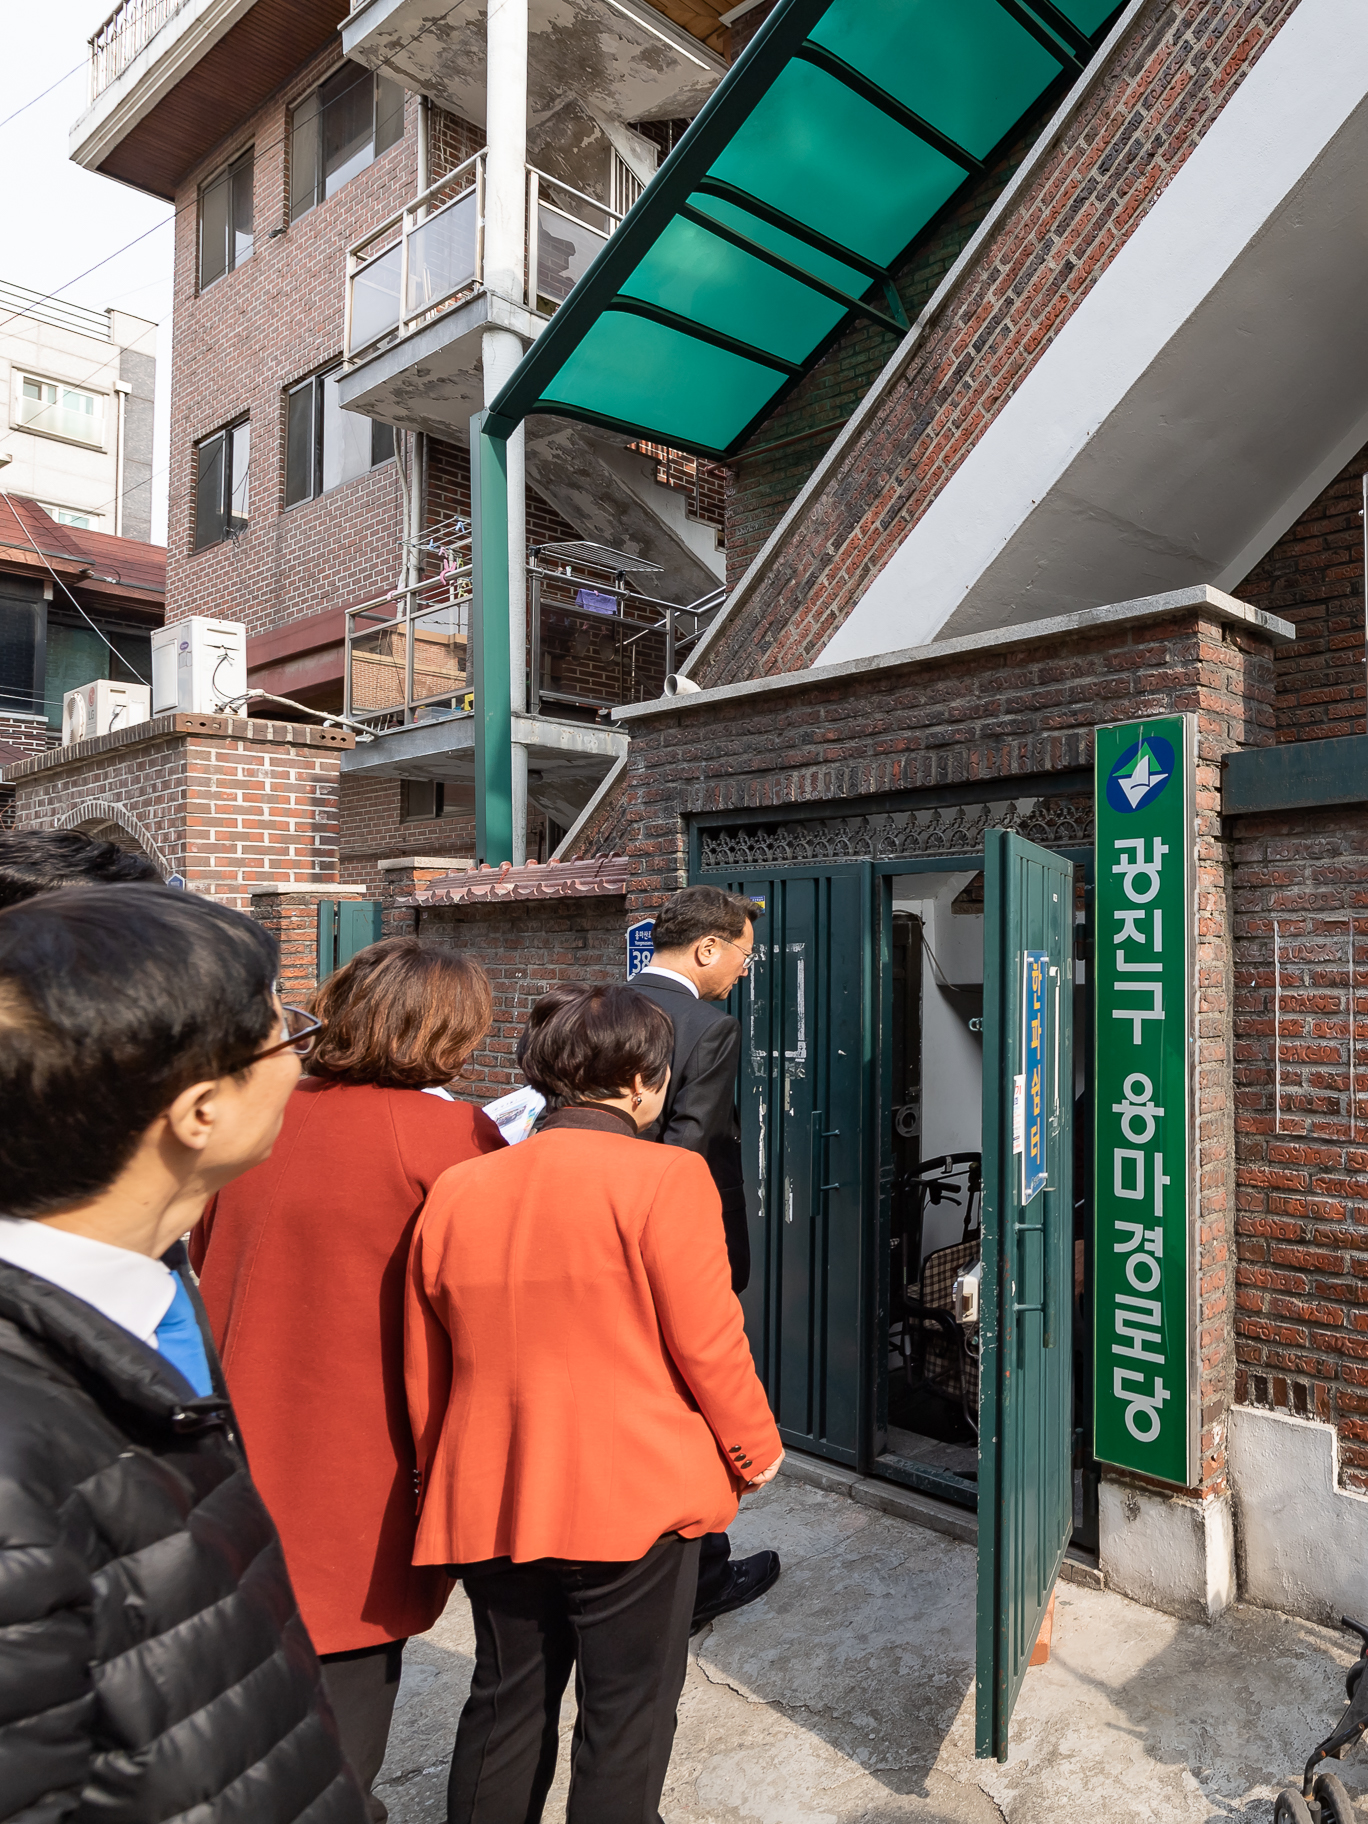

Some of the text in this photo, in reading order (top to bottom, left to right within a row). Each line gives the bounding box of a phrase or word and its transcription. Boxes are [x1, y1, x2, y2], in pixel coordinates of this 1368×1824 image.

[88, 709, 95, 721] LG
[632, 950, 651, 973] 38
[1030, 961, 1042, 1165] 한파쉼터
[1112, 837, 1170, 1442] 광진구 용마경로당
